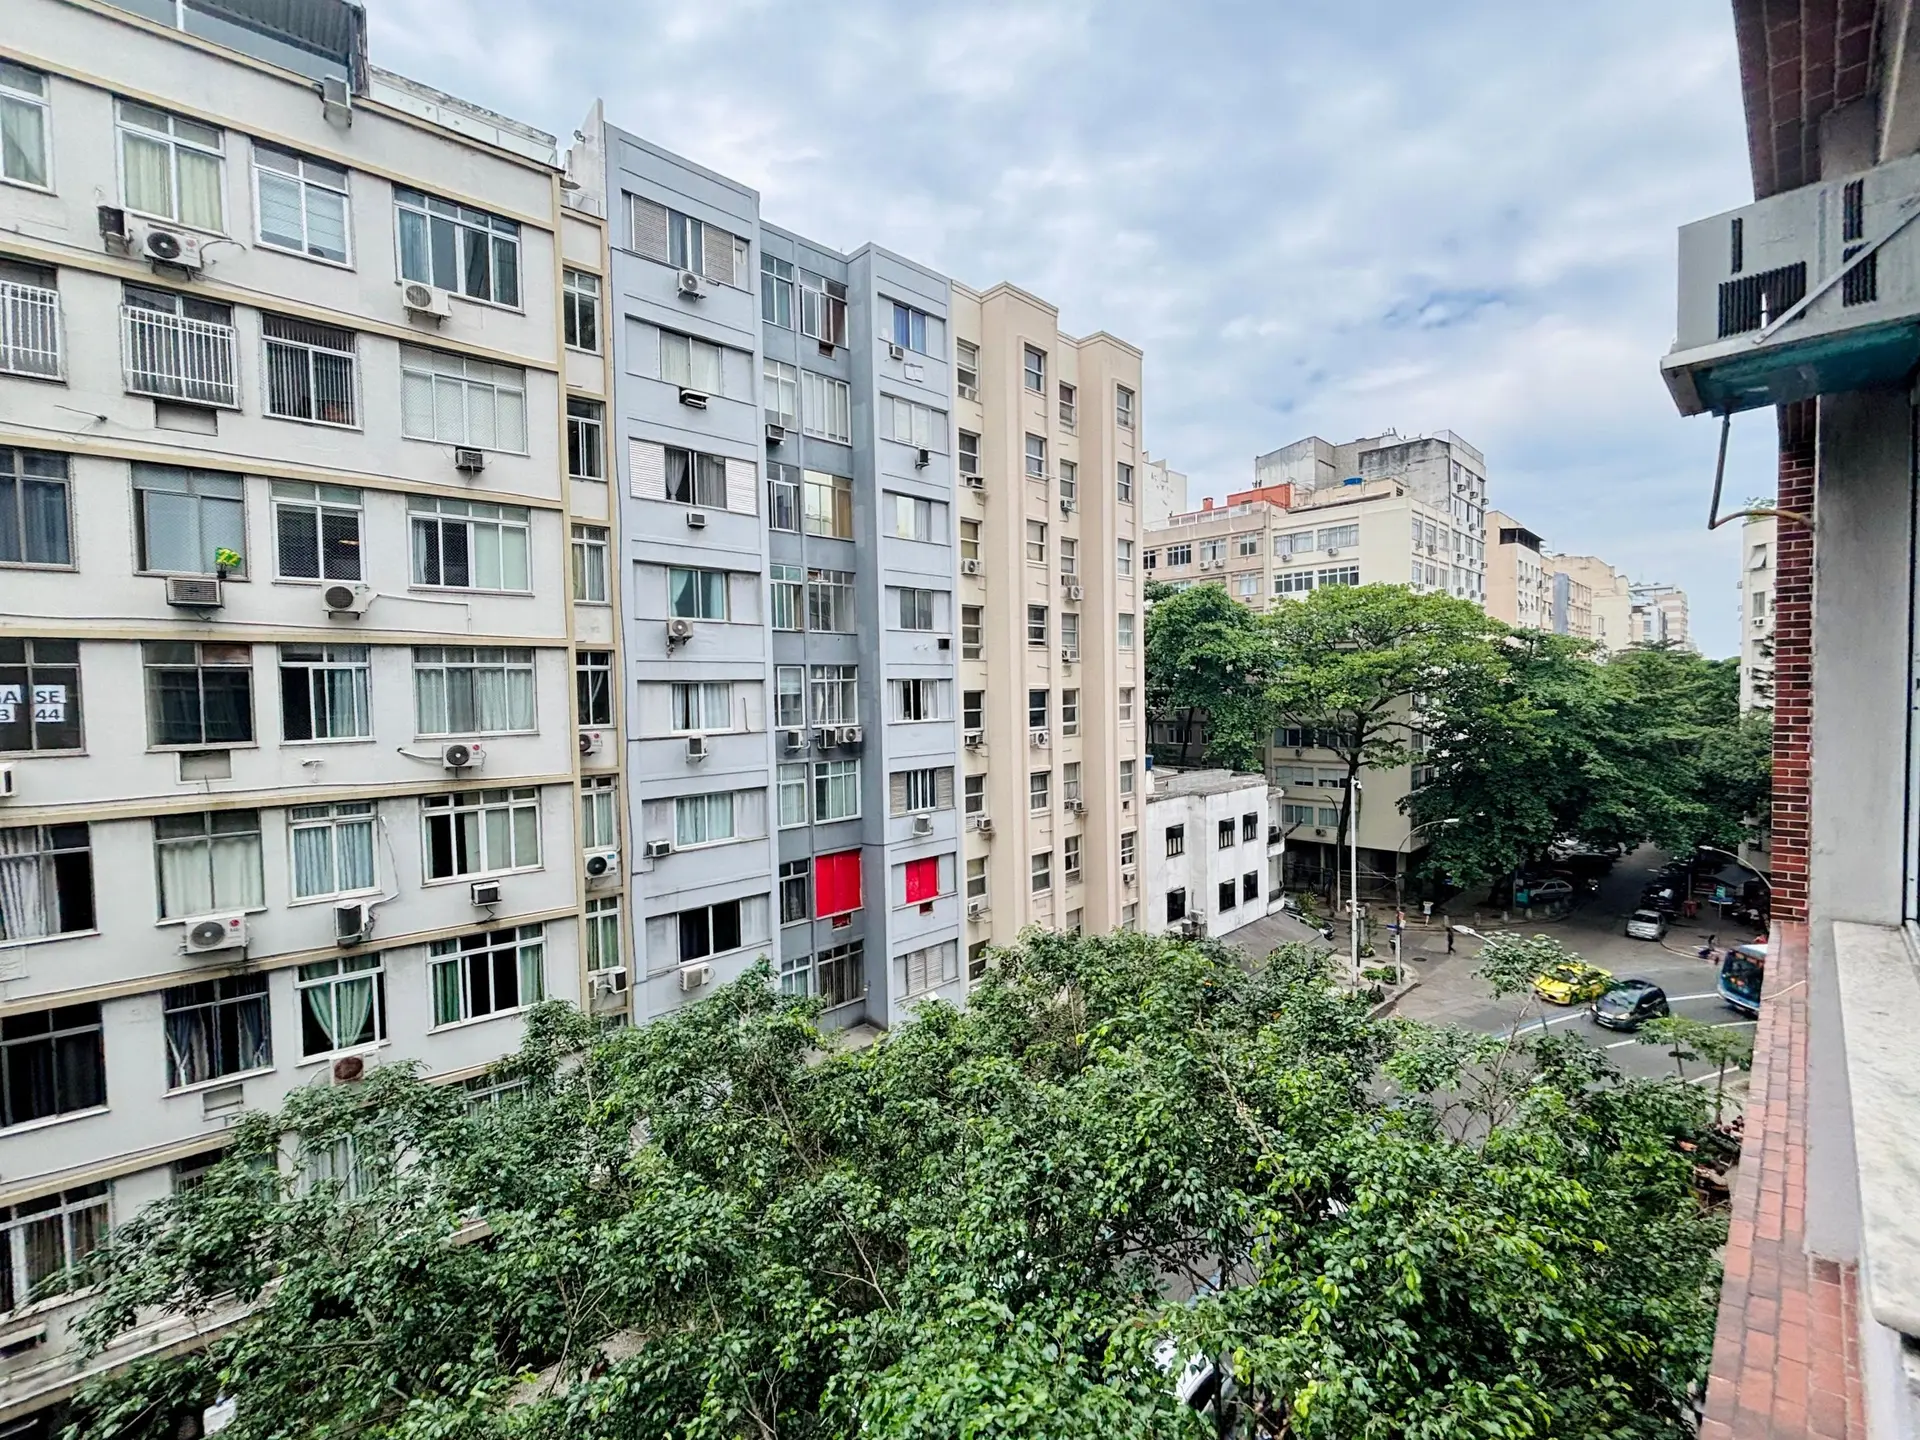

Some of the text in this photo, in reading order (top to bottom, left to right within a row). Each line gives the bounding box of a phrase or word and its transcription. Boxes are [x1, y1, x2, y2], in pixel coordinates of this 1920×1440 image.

[0, 691, 60, 704] A SE
[35, 709, 60, 721] 44
